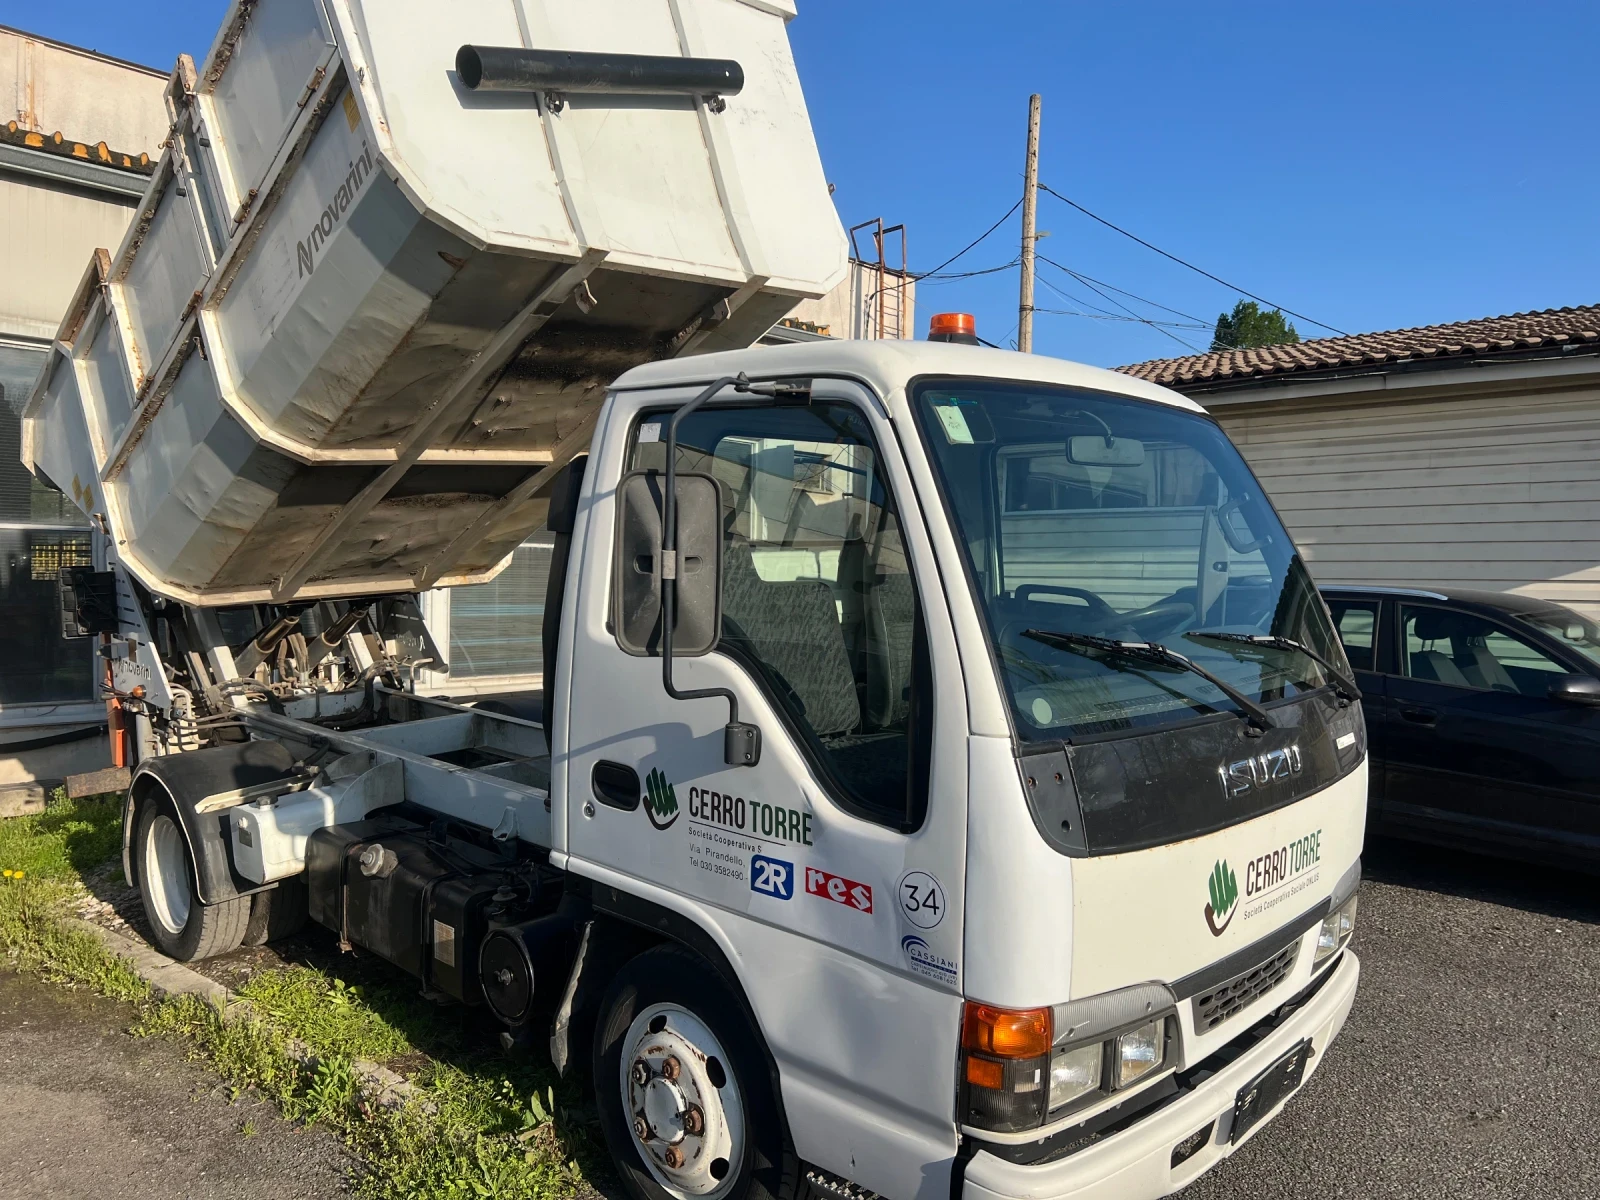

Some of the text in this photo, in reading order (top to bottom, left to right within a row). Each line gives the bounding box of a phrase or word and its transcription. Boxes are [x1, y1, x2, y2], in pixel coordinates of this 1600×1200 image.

[1217, 744, 1304, 800] ISUZU
[689, 786, 814, 847] CERRO TORRE
[688, 826, 713, 841] Società
[713, 833, 756, 852] Cooperativa
[689, 843, 746, 868] Via Pirandello,
[689, 856, 699, 868] Tel
[700, 860, 713, 872] 030
[714, 864, 744, 881] 3582490
[754, 859, 788, 897] 2R
[1246, 829, 1322, 897] CERRO TORRE
[807, 868, 872, 912] res
[904, 883, 940, 916] 34
[1243, 901, 1263, 921] Società
[1263, 890, 1291, 911] Cooperativa
[1290, 883, 1306, 898] Sociale
[910, 948, 958, 970] CASSIANI
